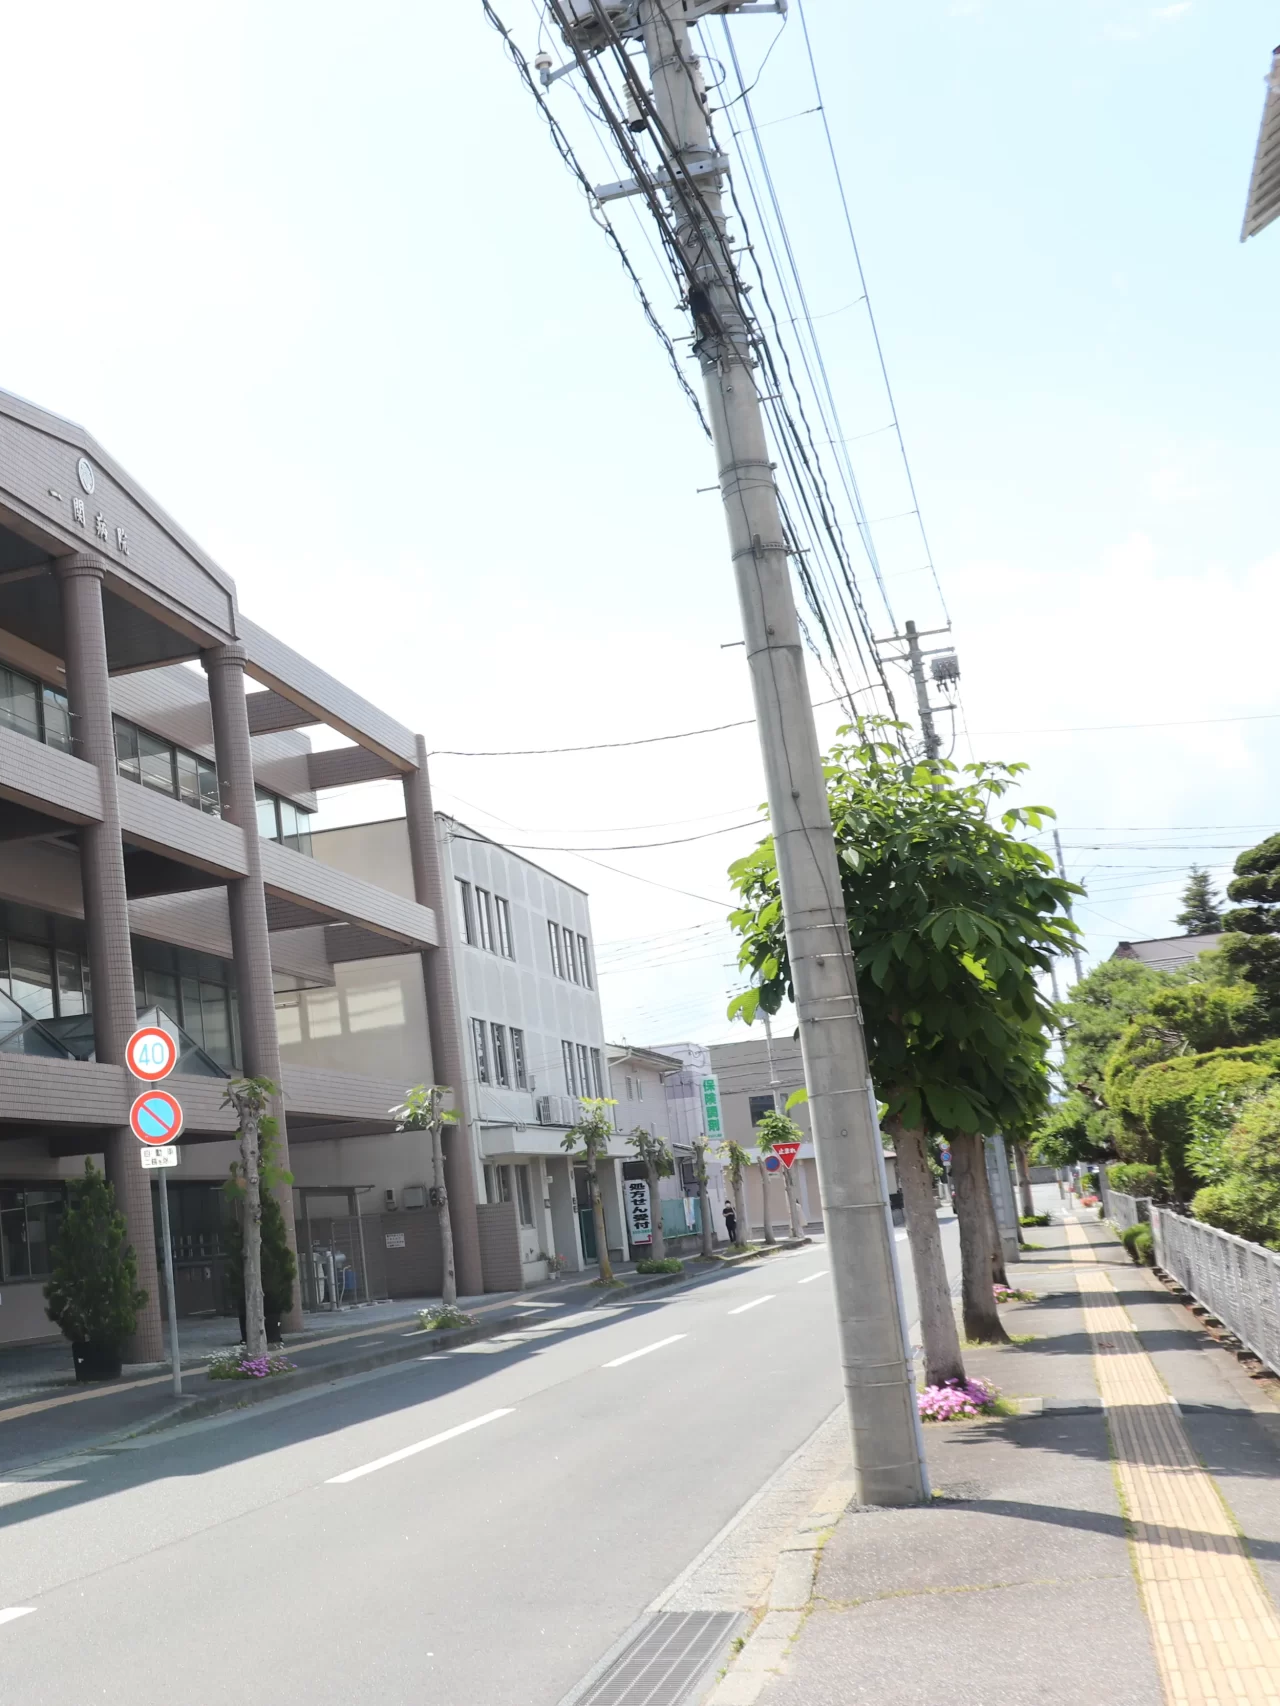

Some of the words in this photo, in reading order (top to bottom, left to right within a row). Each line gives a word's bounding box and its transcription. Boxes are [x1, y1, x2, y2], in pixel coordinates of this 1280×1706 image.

[139, 1042, 165, 1066] 40
[703, 1079, 720, 1132] 保険調剤
[778, 1147, 797, 1155] 止まれ
[629, 1183, 650, 1230] 処方せん受付
